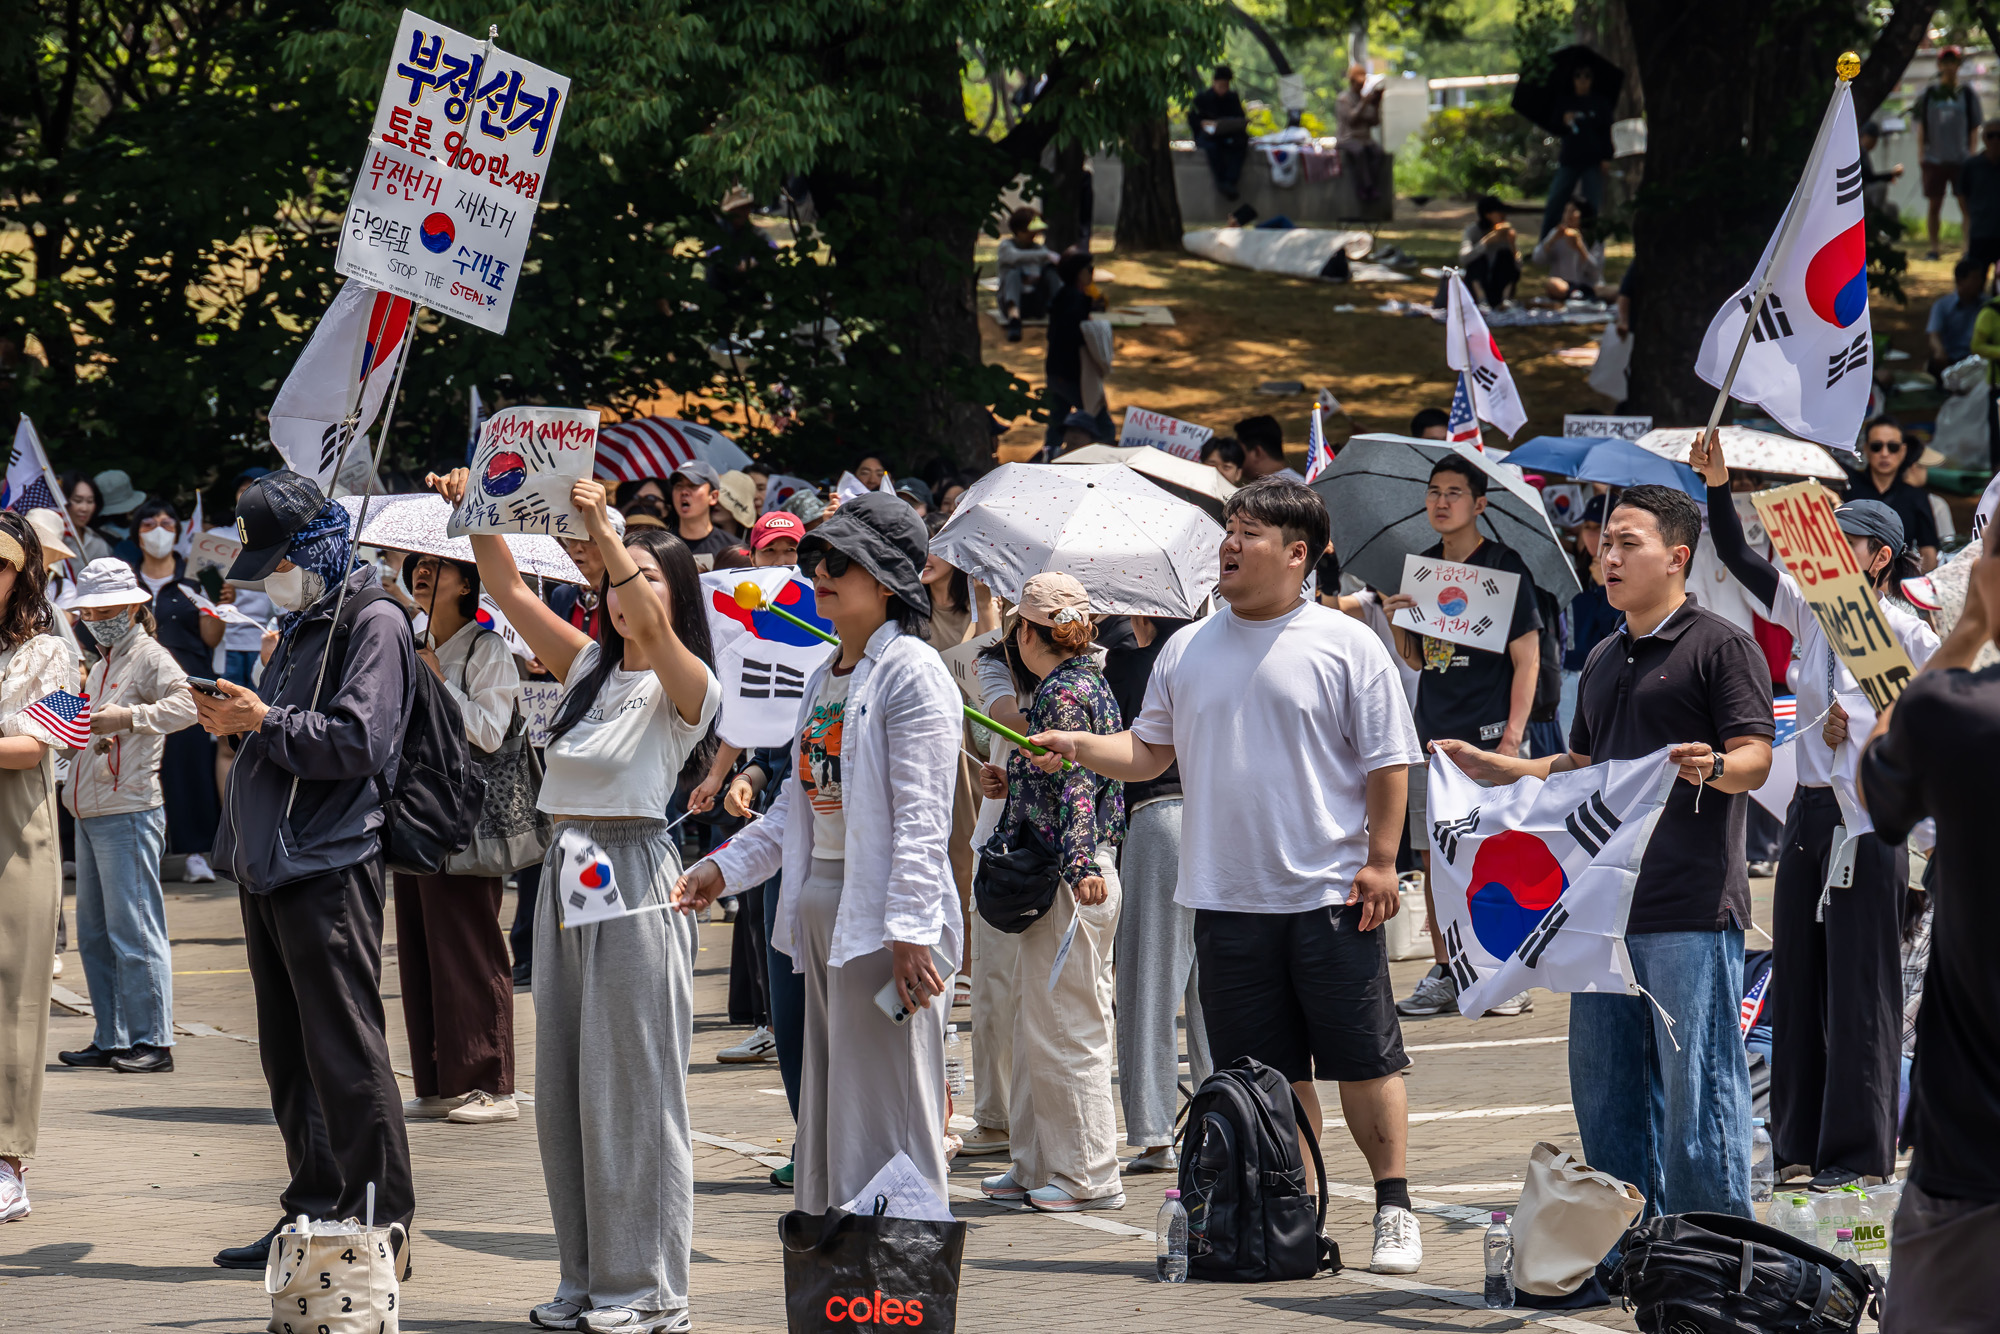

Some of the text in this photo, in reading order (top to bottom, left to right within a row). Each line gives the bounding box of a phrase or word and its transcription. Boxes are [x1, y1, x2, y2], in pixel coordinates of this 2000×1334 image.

[396, 29, 562, 157] 부정선거
[369, 151, 517, 238] 부정선거 재선거
[352, 208, 511, 291] 당일투표 수개표
[387, 258, 418, 280] STOP
[424, 270, 445, 289] THE
[521, 687, 564, 710] 부정선
[1852, 1225, 1885, 1241] MG
[340, 1248, 357, 1264] 4
[378, 1242, 387, 1258] 9
[320, 1272, 331, 1289] 5
[297, 1293, 395, 1315] 9 2 3
[825, 1289, 924, 1327] coles
